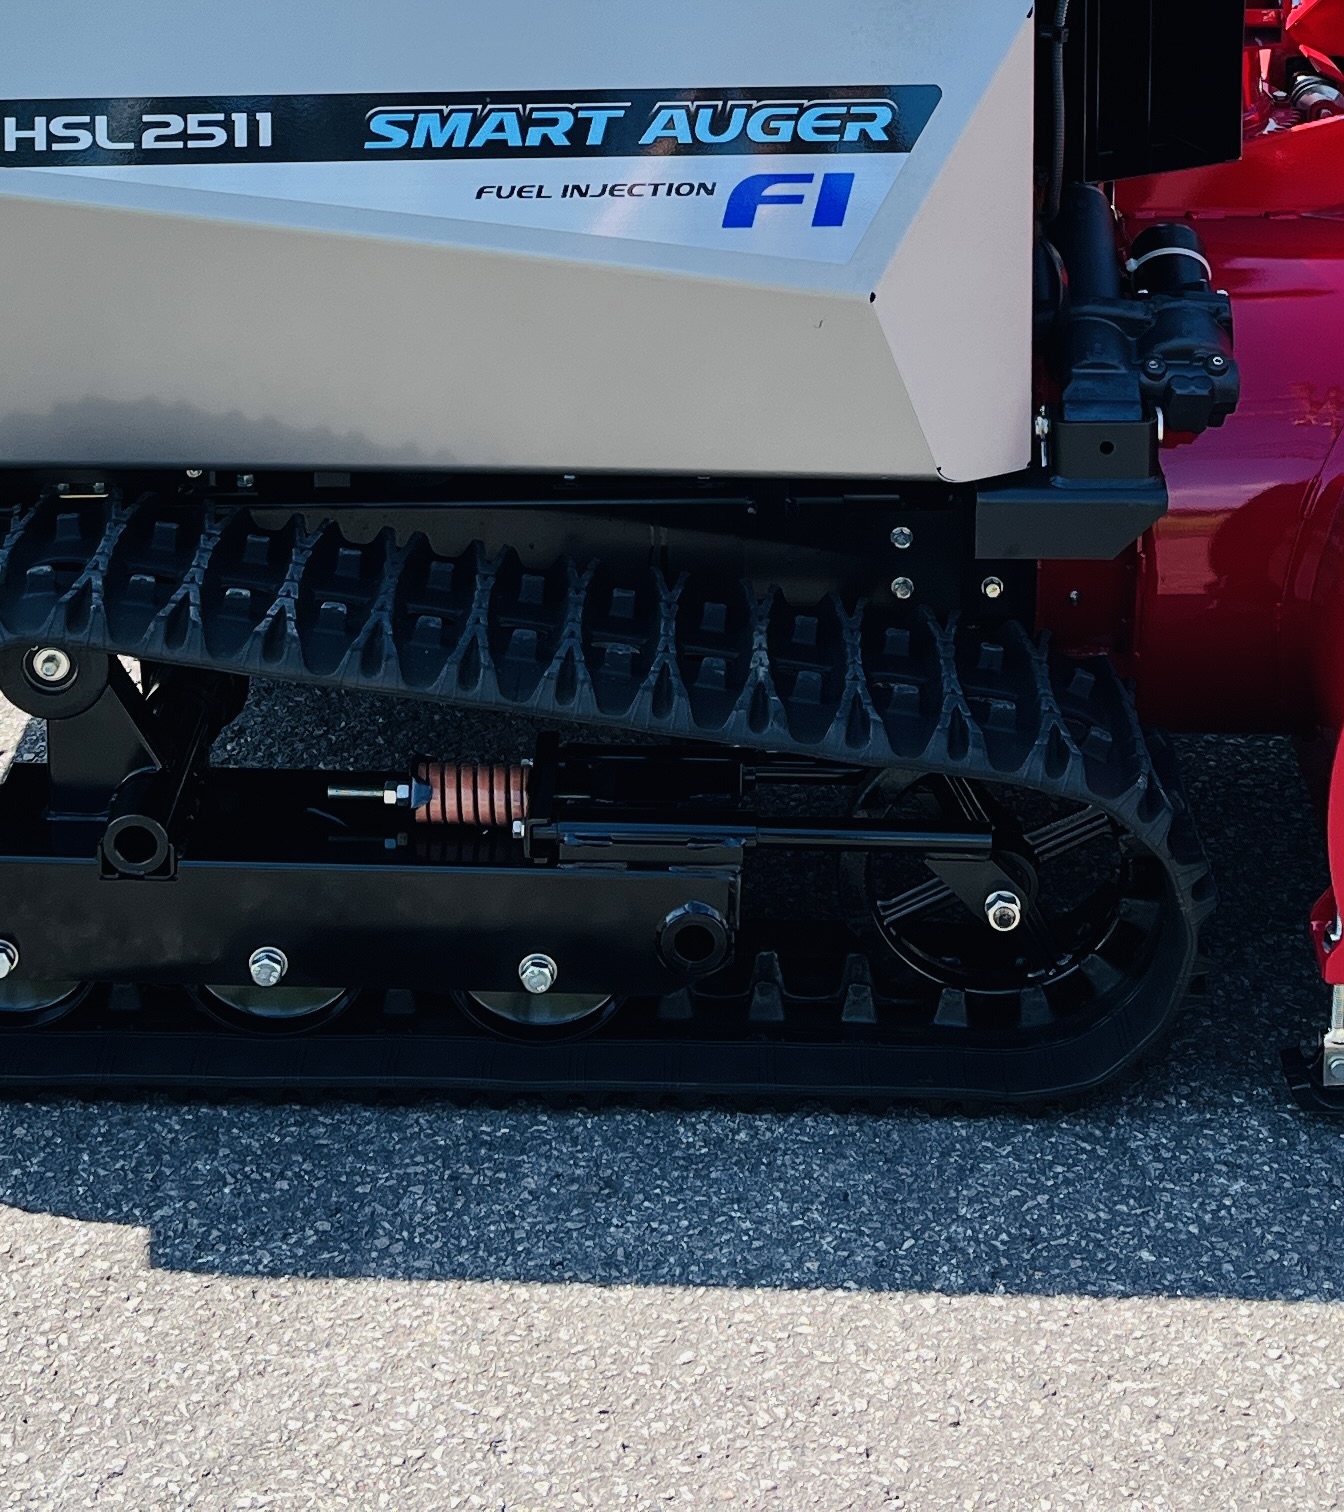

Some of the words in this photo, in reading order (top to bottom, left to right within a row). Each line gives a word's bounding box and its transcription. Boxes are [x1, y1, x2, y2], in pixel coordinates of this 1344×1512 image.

[3, 112, 272, 152] HSL2511
[363, 102, 631, 149] SMART
[638, 99, 898, 145] AUGER
[474, 184, 554, 200] FUEL
[560, 181, 717, 199] INJECTION
[721, 172, 855, 229] FI
